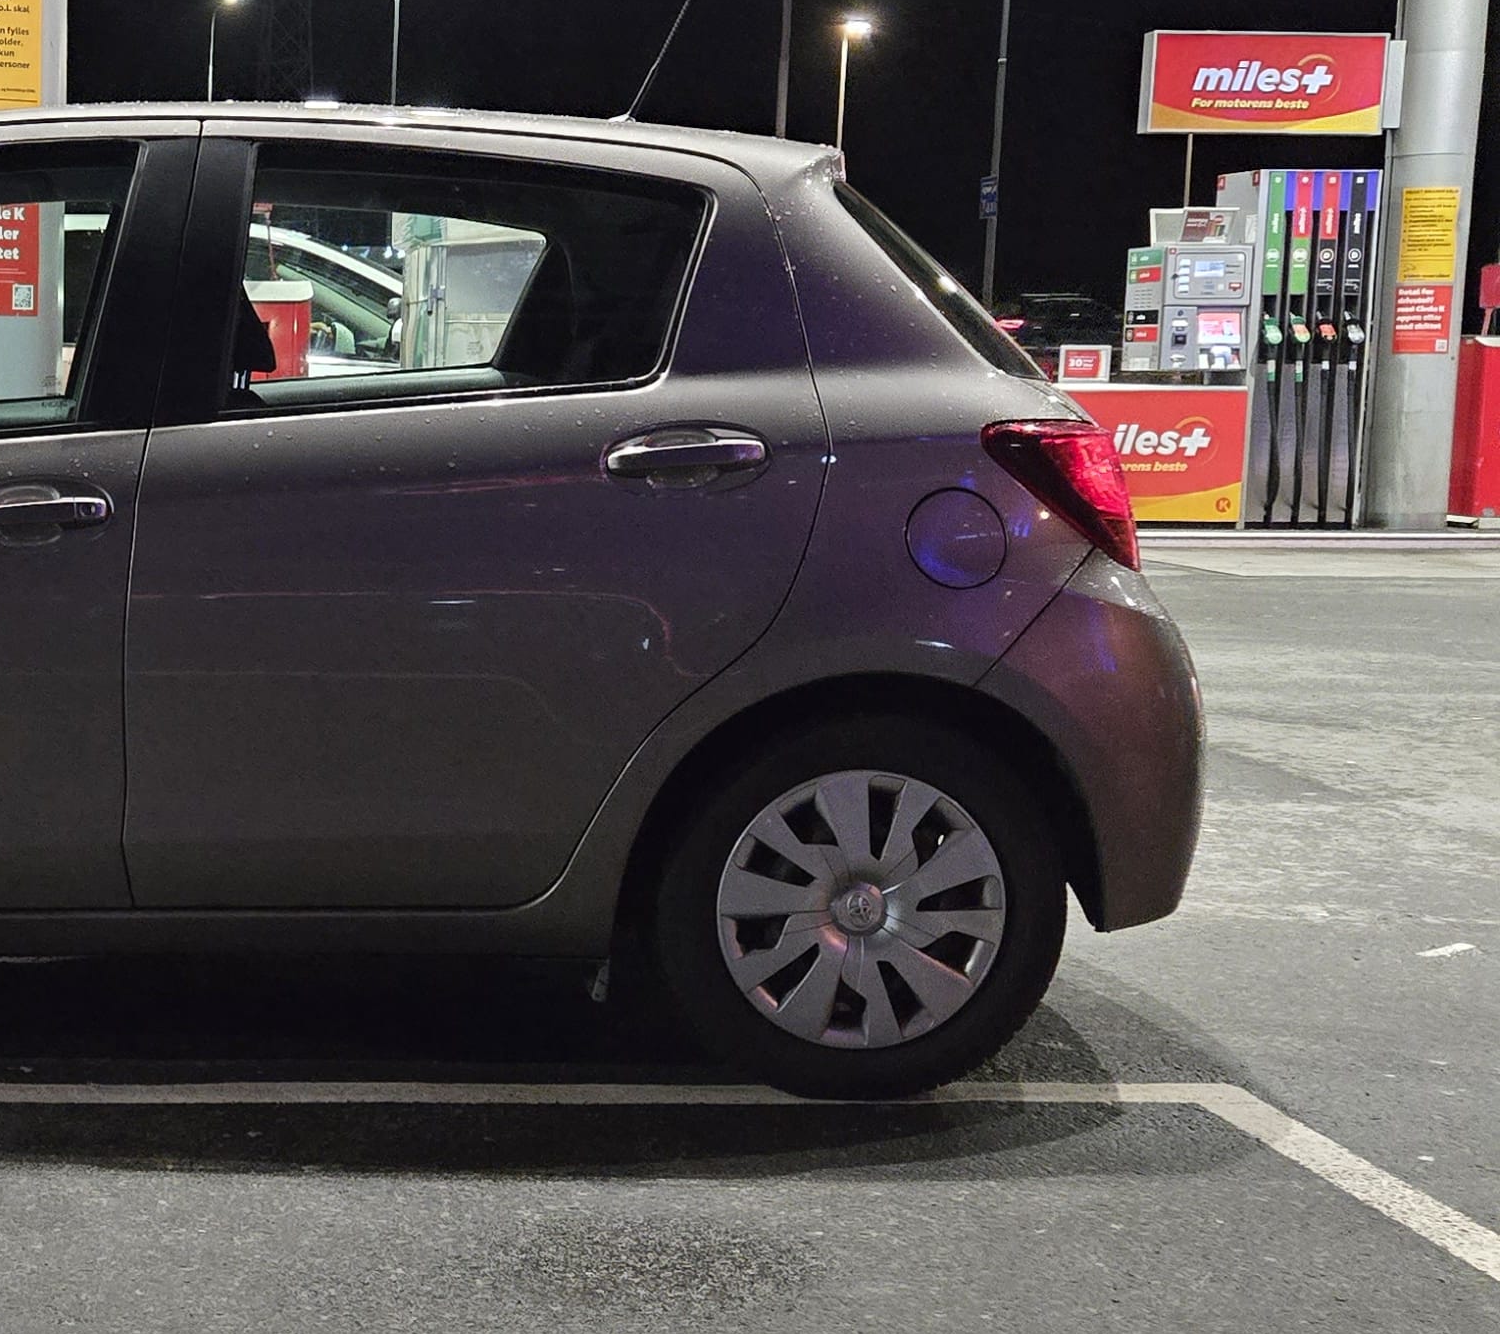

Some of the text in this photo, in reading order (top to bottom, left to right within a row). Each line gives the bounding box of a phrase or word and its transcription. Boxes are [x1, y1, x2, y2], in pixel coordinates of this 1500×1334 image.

[13, 4, 30, 13] skal
[7, 27, 30, 37] fylles
[1192, 60, 1334, 95] miles+
[1191, 97, 1309, 109] For motorens beste
[14, 207, 25, 221] K
[1153, 461, 1188, 472] beste
